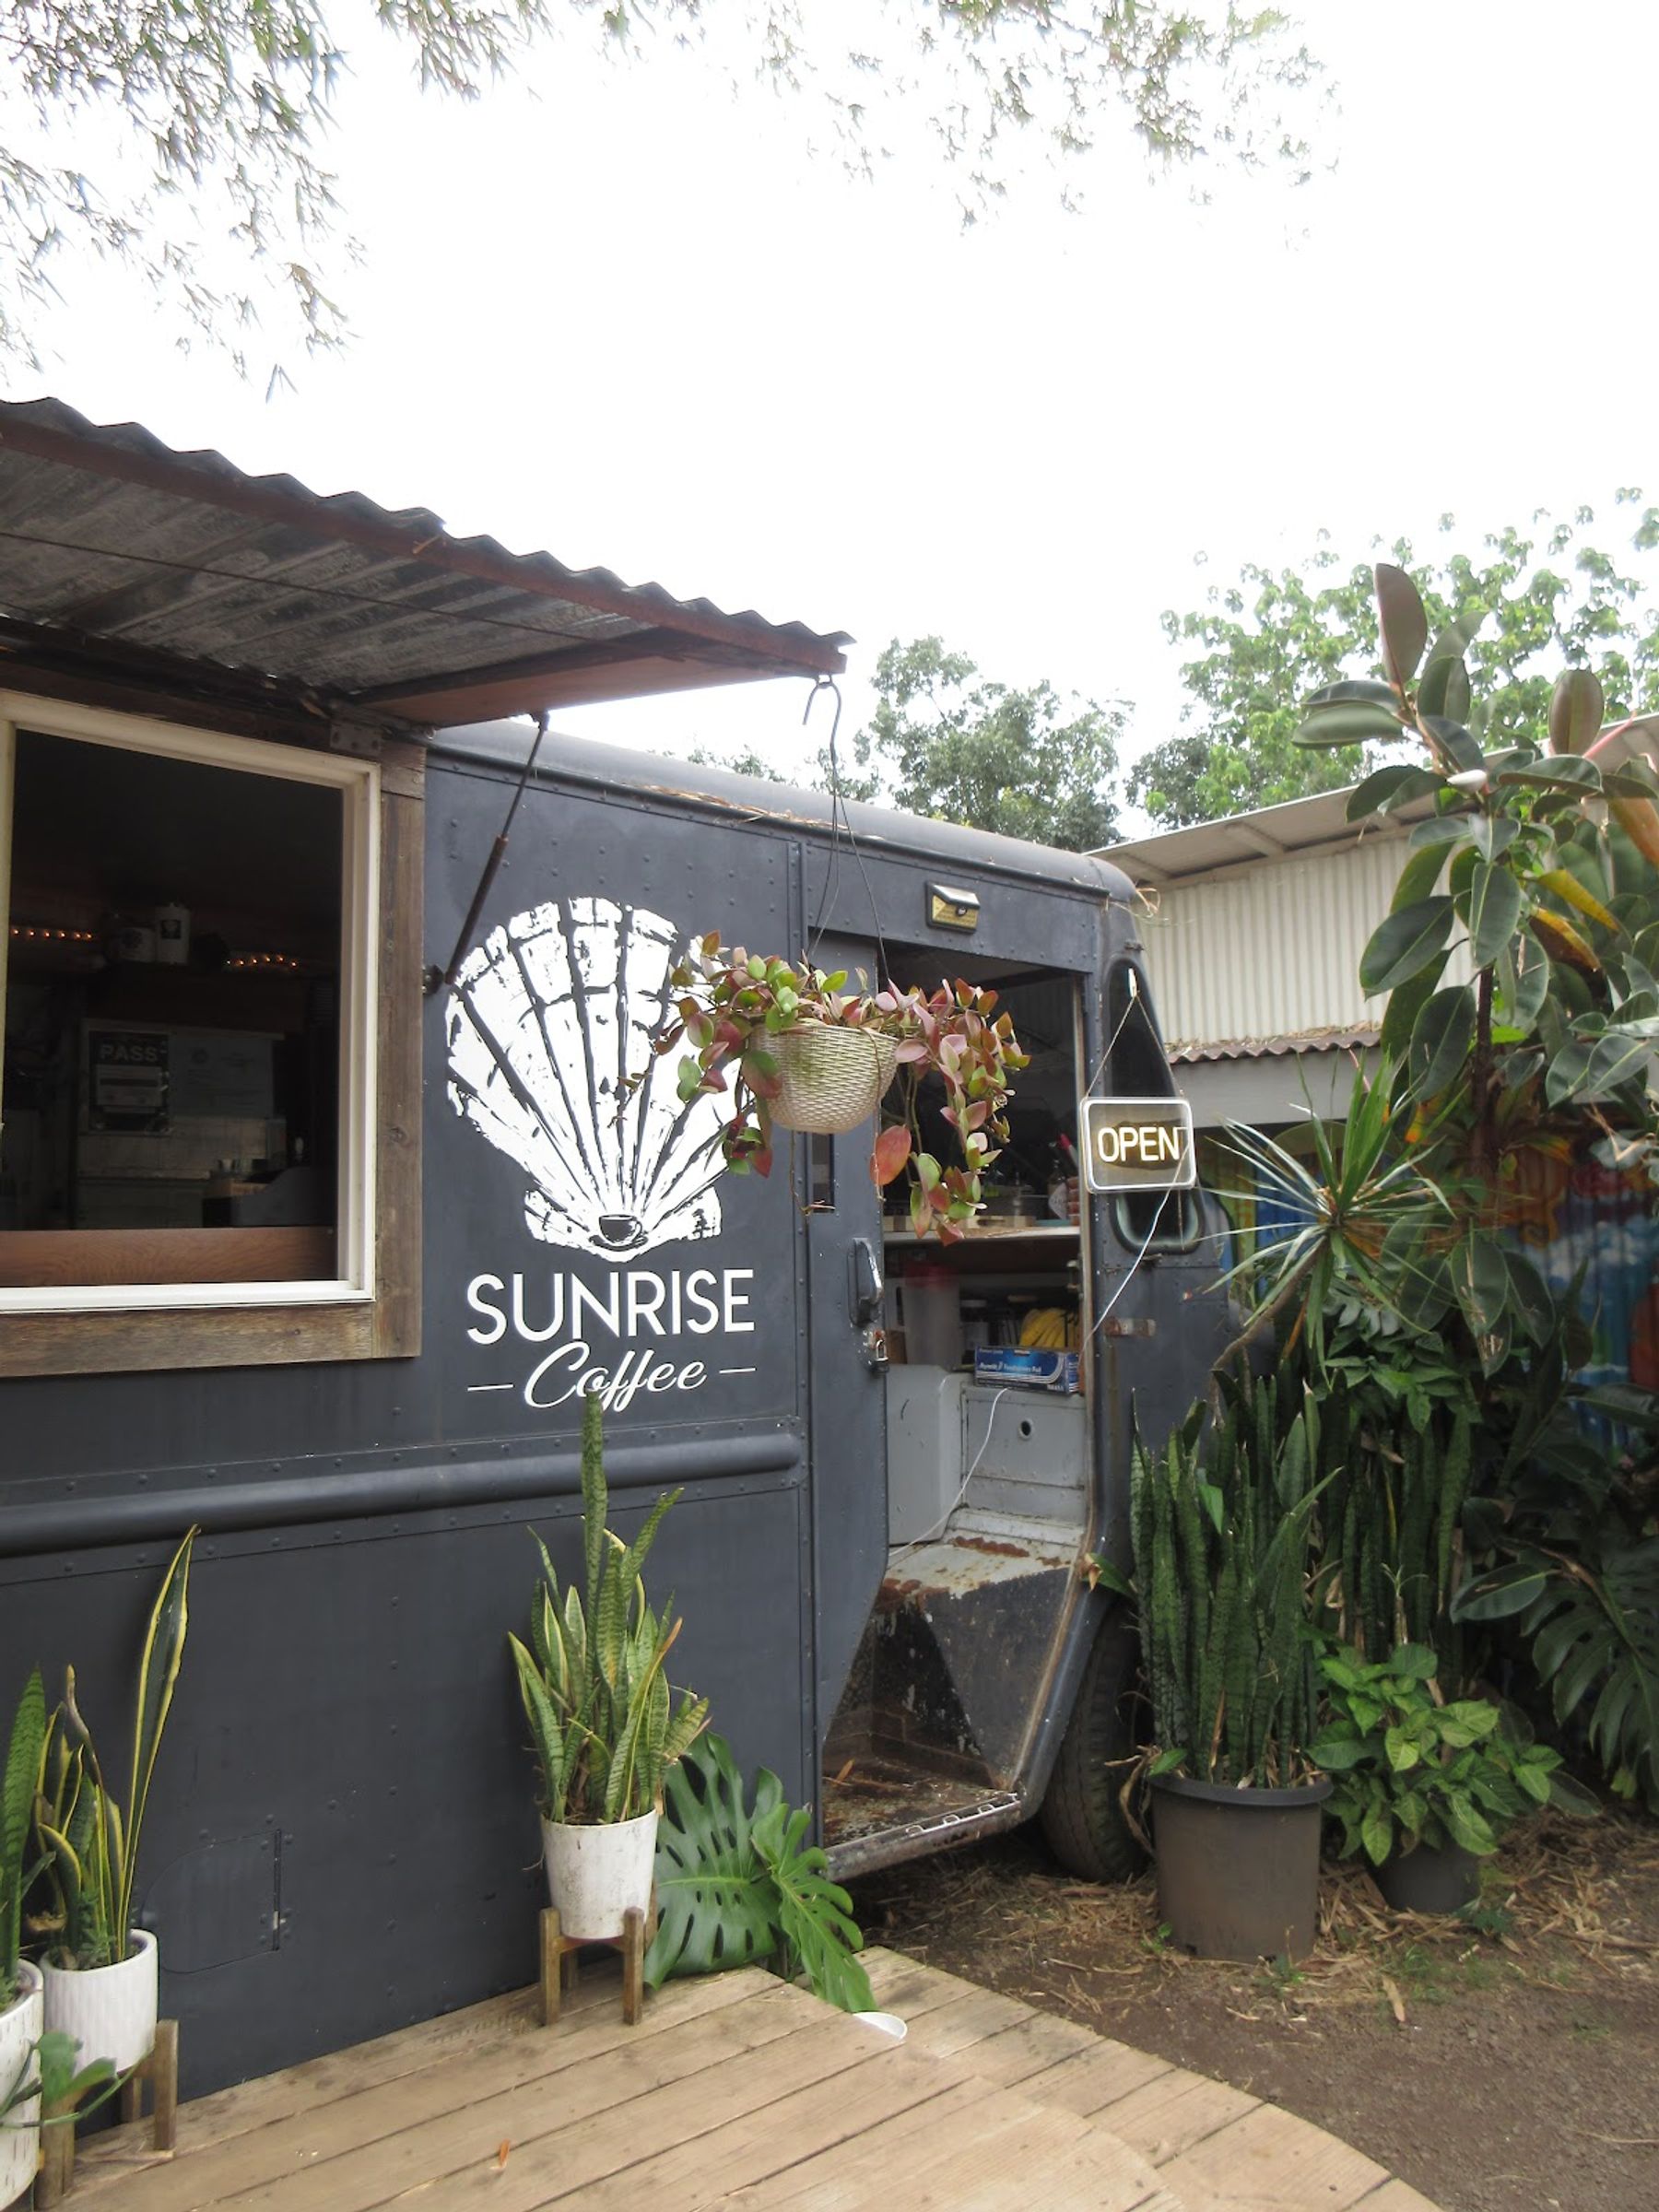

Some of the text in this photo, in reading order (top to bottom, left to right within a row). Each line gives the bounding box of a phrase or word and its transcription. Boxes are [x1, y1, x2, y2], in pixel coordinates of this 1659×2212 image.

[100, 1043, 158, 1063] PASS
[1098, 1126, 1180, 1162] OPEN
[466, 1269, 755, 1345] SUNRISE
[524, 1341, 708, 1413] Coffee
